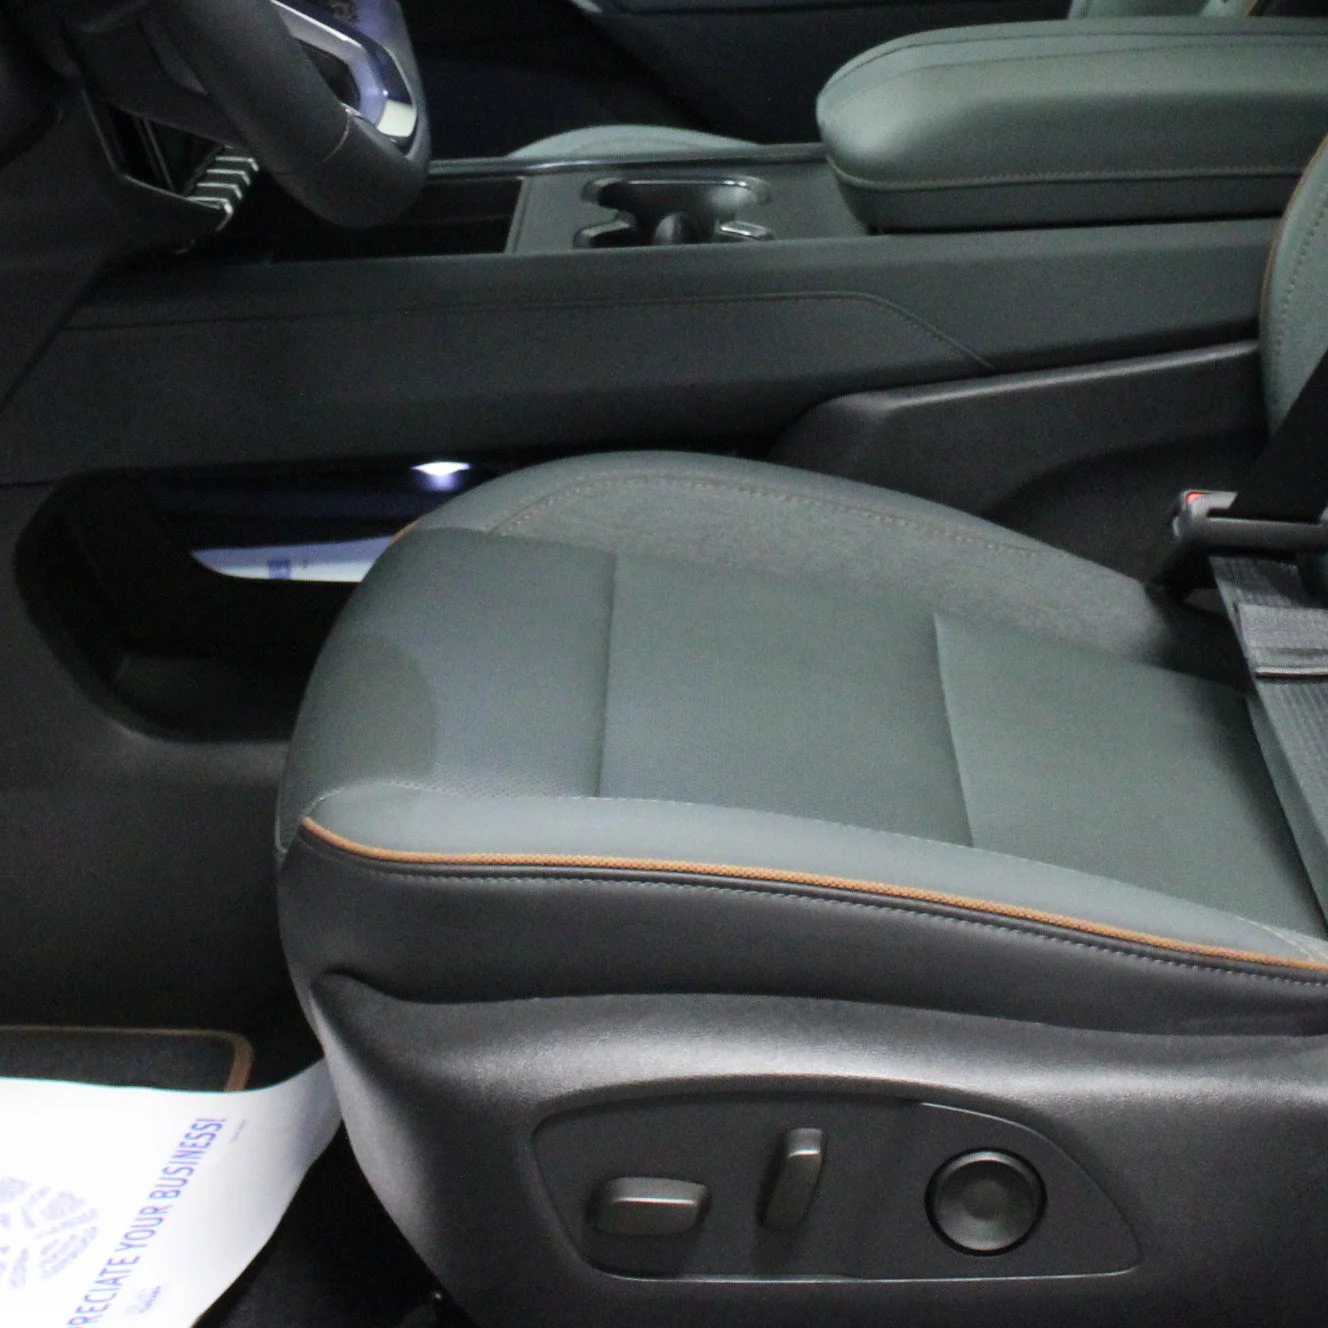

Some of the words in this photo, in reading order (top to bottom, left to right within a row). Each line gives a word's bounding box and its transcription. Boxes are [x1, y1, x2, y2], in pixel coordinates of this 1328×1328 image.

[66, 1255, 141, 1328] RECIATE
[114, 1204, 173, 1252] YOUR
[148, 1118, 228, 1199] BUSINESS!
